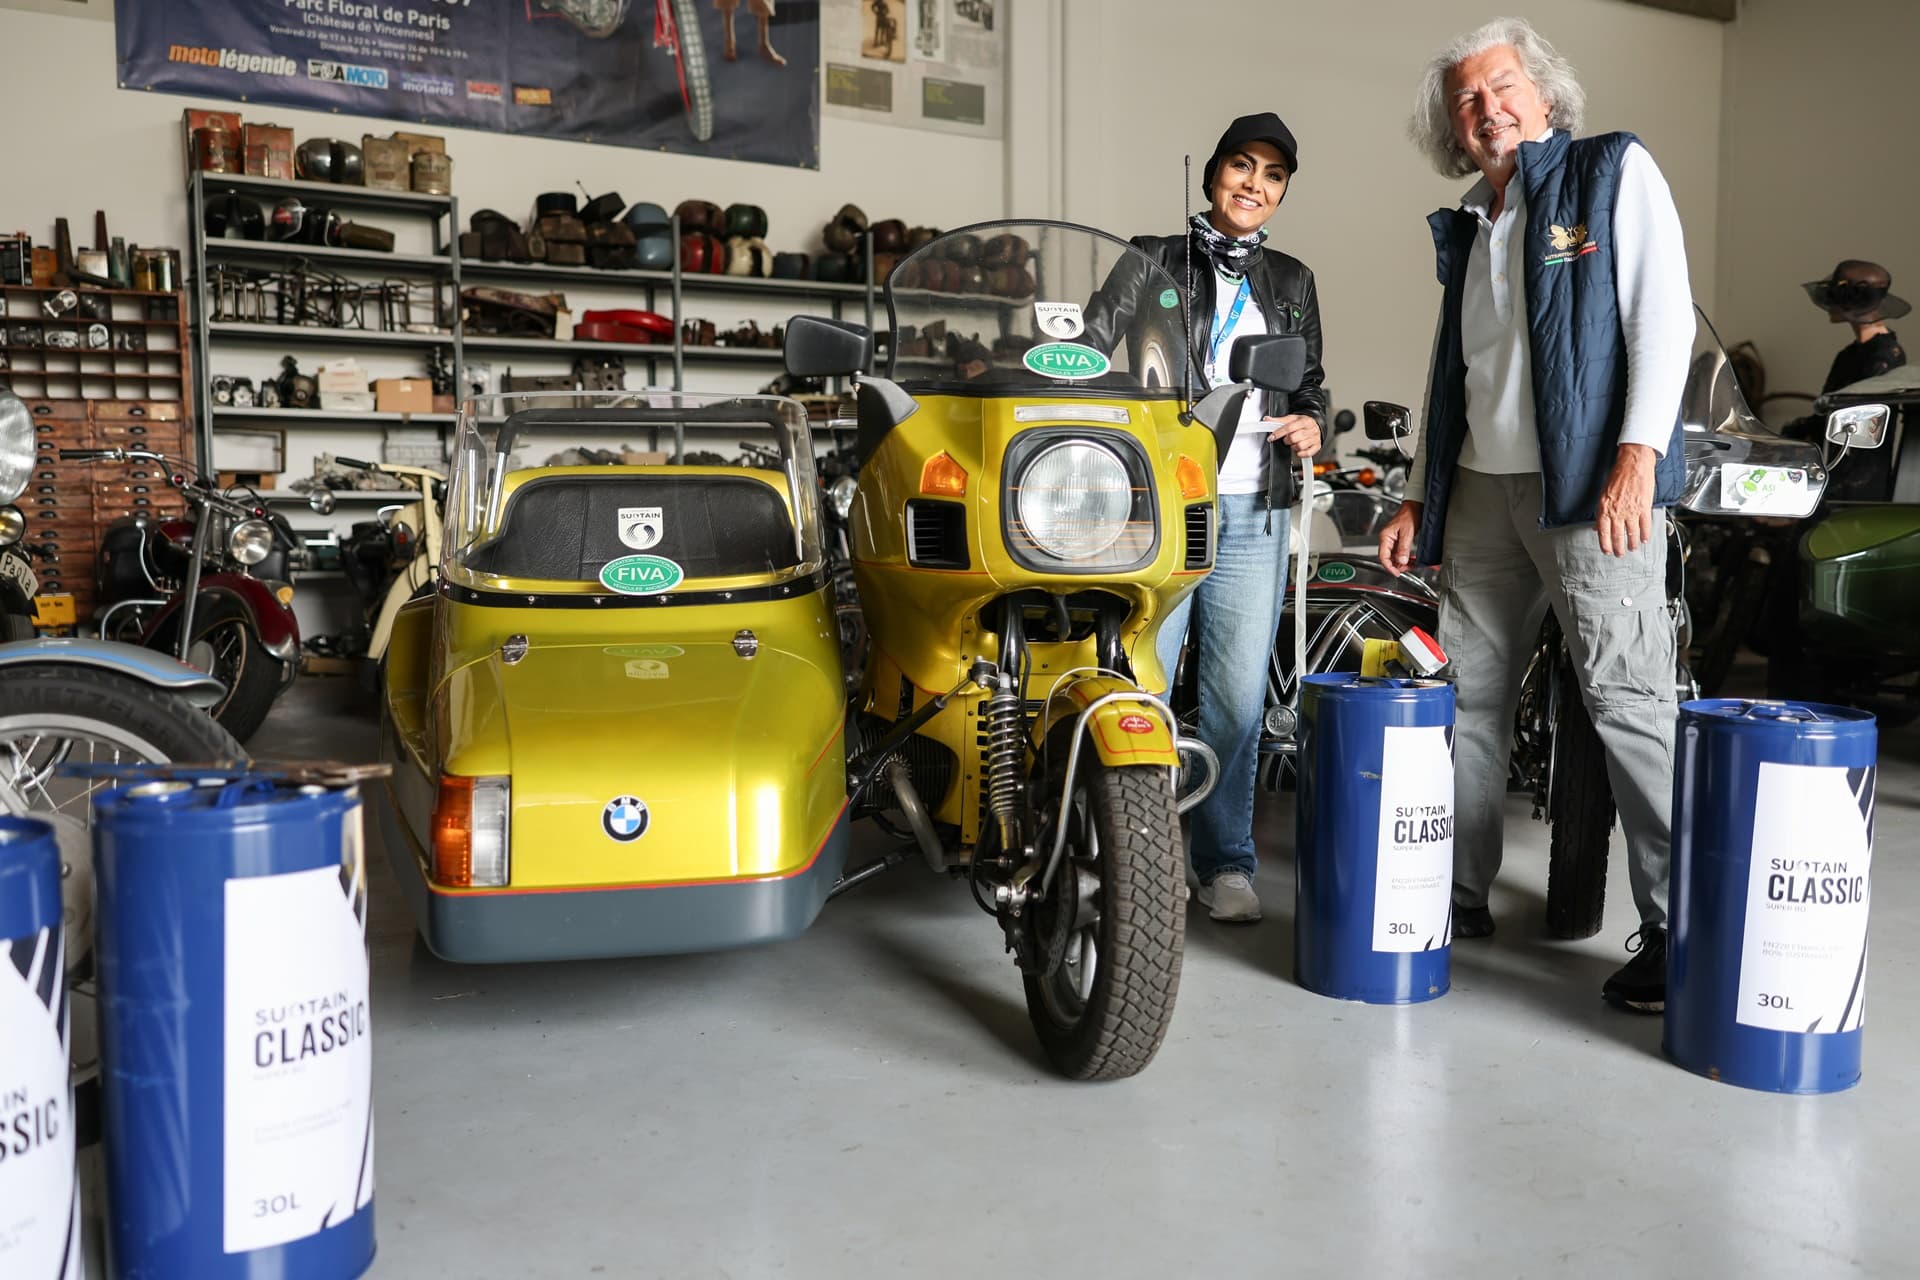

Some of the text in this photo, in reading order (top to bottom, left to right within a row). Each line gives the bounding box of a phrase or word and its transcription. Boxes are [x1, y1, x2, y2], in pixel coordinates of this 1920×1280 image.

[328, 0, 379, 20] Floral
[383, 6, 403, 23] de
[407, 9, 451, 30] Paris
[357, 20, 372, 33] de
[168, 44, 297, 77] motolégende
[347, 65, 386, 87] MOTO
[1042, 353, 1092, 368] FIVA
[617, 567, 665, 581] FIVA
[1325, 567, 1347, 576] FIVA
[1393, 814, 1454, 844] CLASSIC
[1767, 873, 1863, 905] CLASSIC
[1388, 922, 1416, 935] 30L
[1757, 992, 1794, 1010] 30L
[254, 999, 365, 1069] CLASSIC
[252, 1191, 302, 1219] 30L
